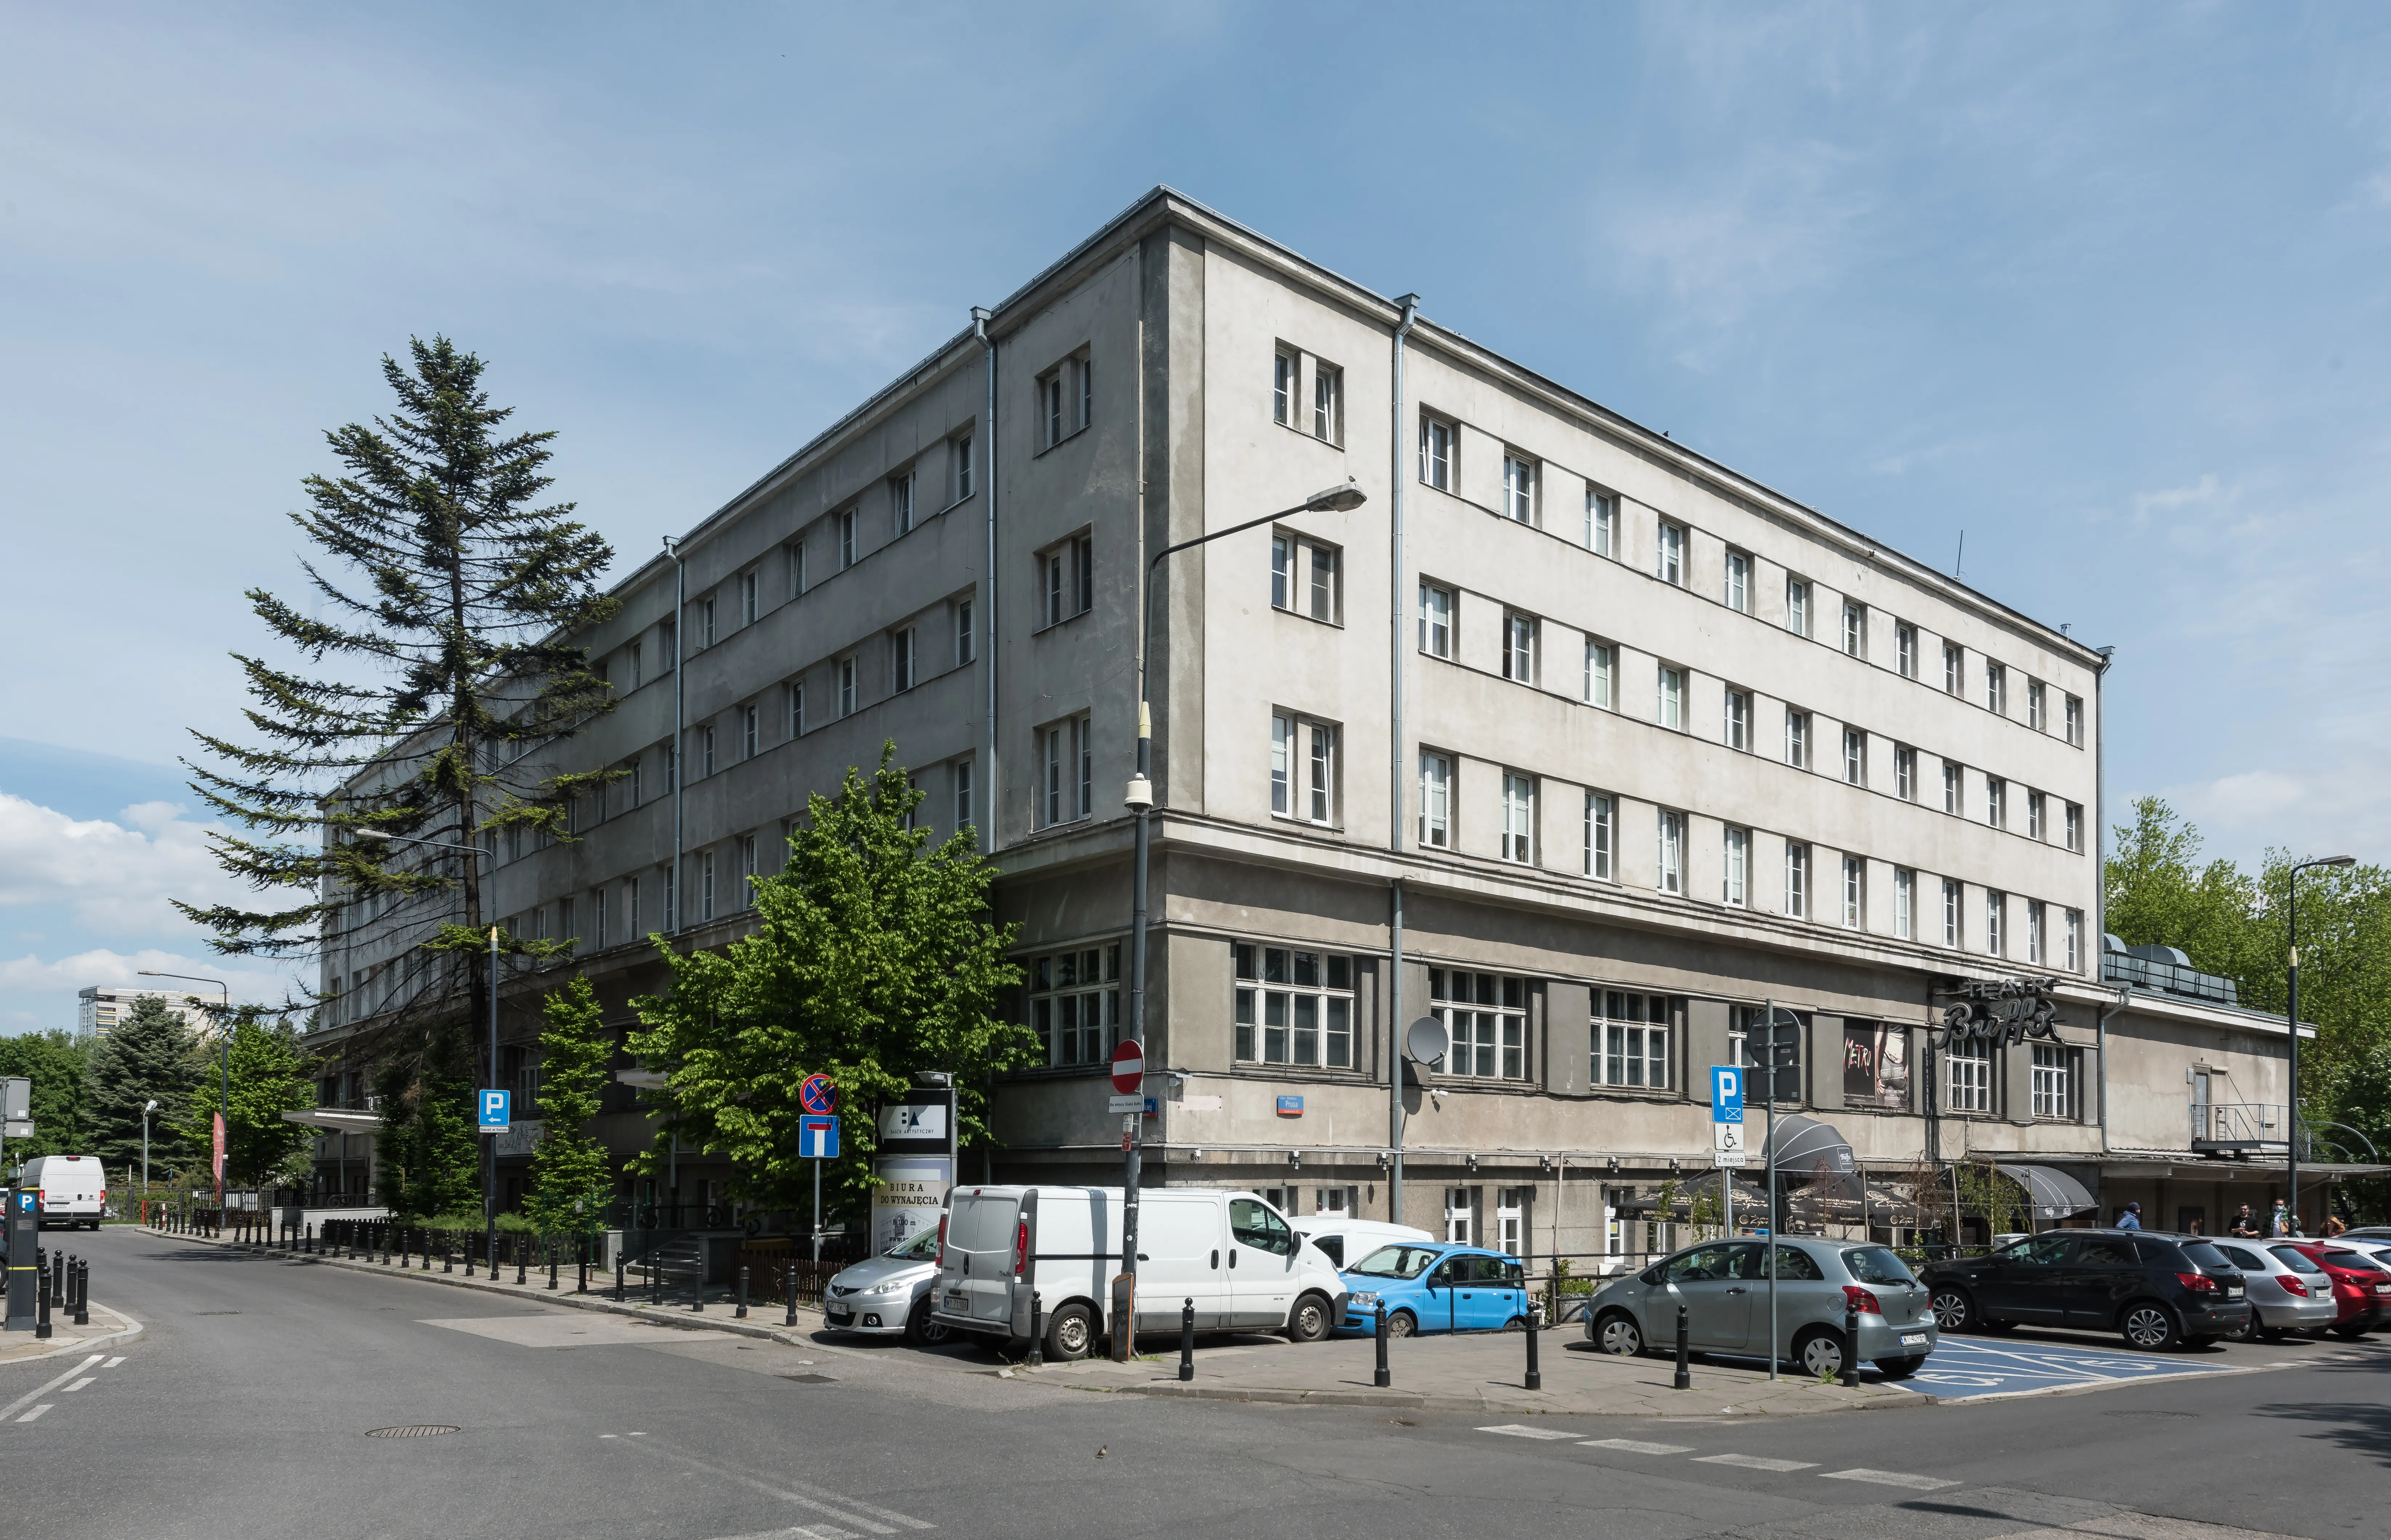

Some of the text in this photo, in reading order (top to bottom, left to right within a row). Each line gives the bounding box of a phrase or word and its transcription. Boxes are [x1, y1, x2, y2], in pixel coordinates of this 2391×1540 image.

[1963, 976, 2054, 998] TEATR
[1935, 997, 2055, 1050] Buffo
[1844, 1037, 1871, 1076] METRO
[1719, 1071, 1736, 1106] P
[486, 1093, 503, 1114] P
[1723, 1156, 1743, 1164] miejsca
[890, 1183, 923, 1192] BIURA
[22, 1195, 33, 1208] P
[881, 1196, 938, 1206] DO WYNAJĘCIA
[946, 1298, 952, 1307] WY
